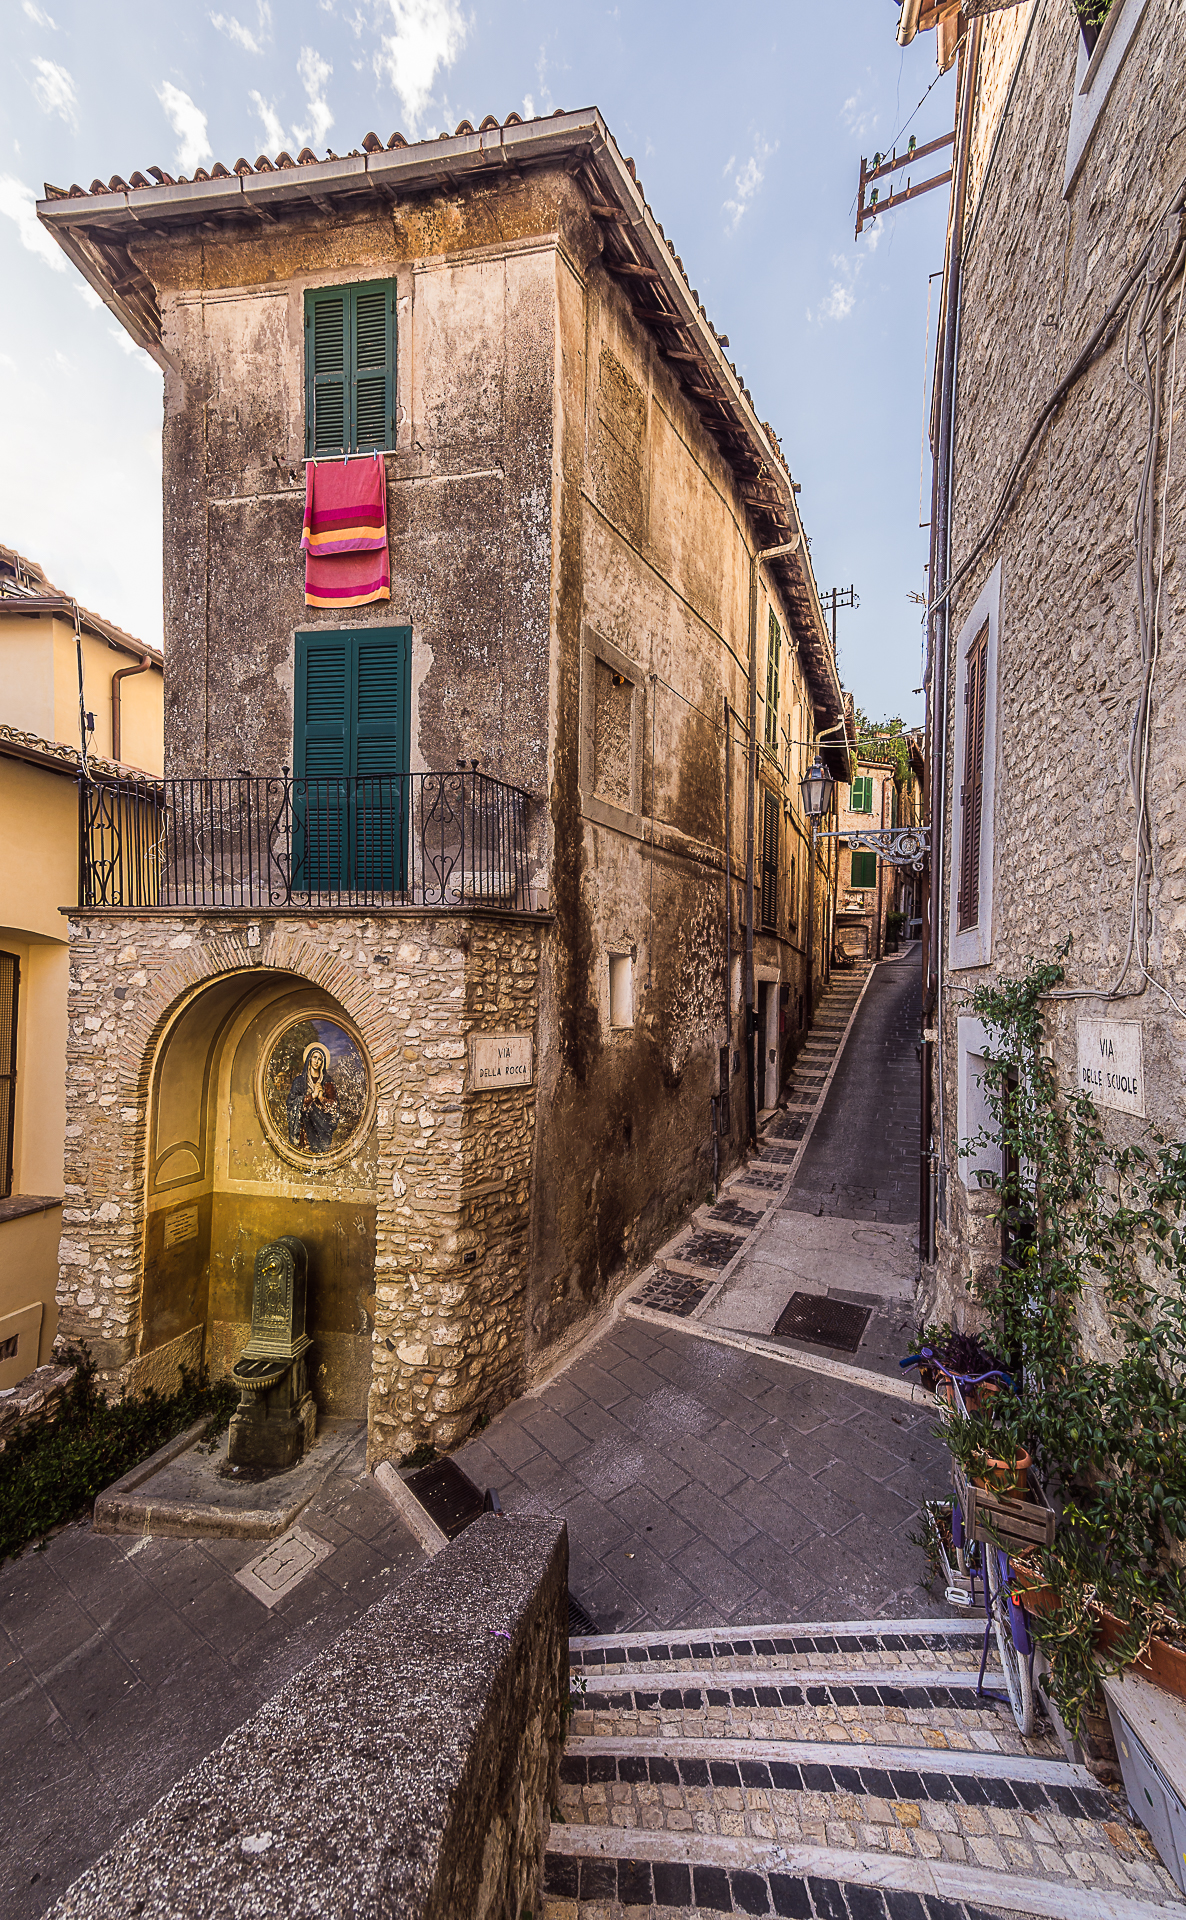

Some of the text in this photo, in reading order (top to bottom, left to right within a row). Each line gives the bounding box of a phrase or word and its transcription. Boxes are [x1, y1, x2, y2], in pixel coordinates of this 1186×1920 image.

[498, 1048, 511, 1058] VIA
[1099, 1037, 1114, 1058] VIA
[479, 1065, 527, 1078] DELLA ROCCA
[1082, 1067, 1138, 1095] DELLE SCUOLE
